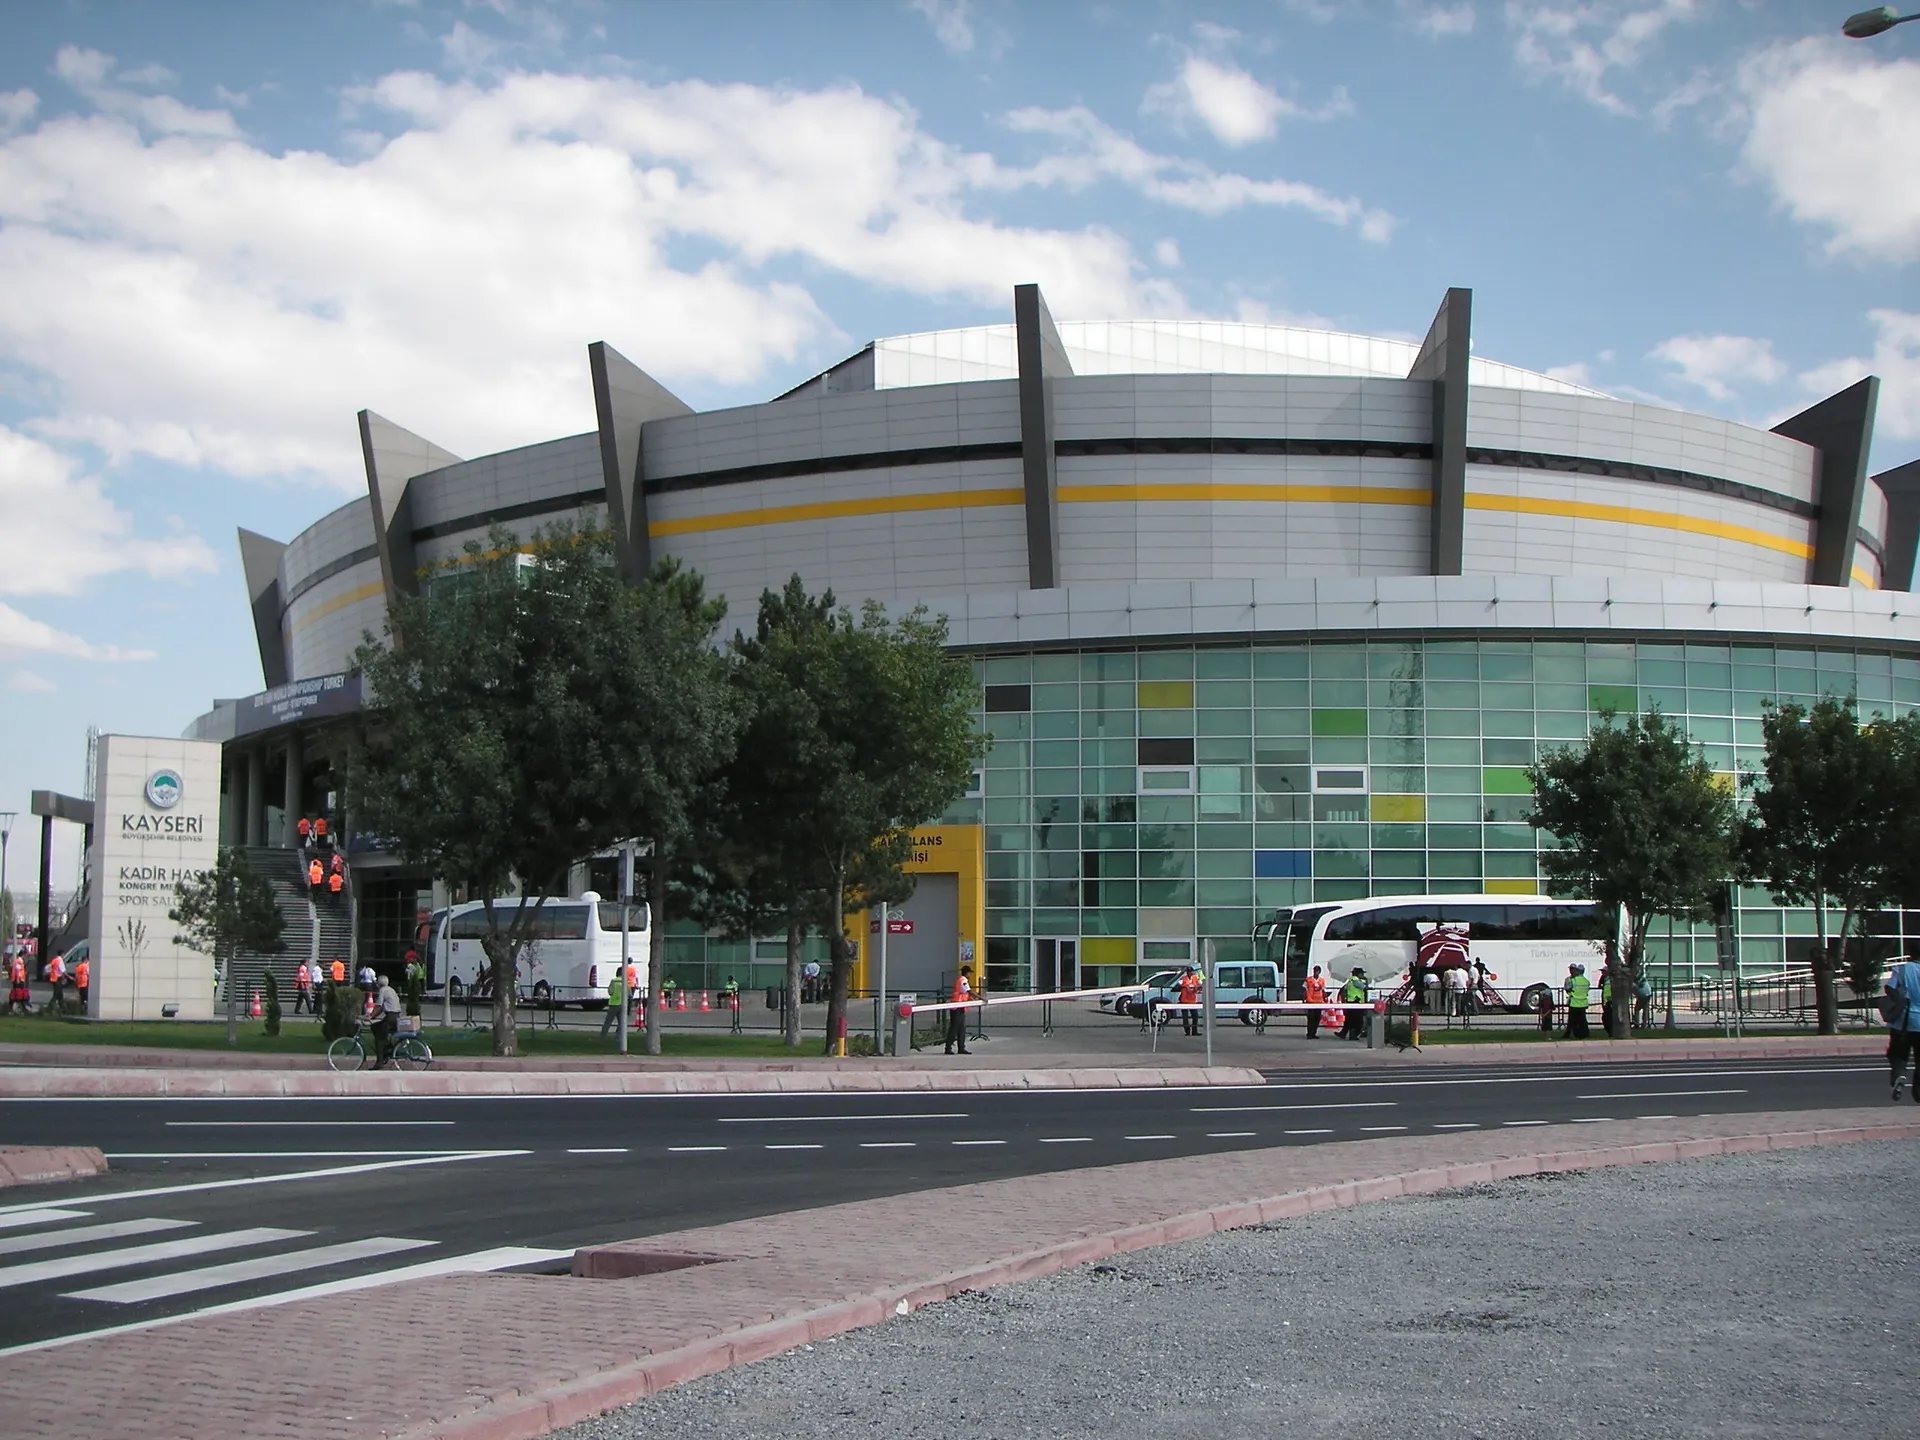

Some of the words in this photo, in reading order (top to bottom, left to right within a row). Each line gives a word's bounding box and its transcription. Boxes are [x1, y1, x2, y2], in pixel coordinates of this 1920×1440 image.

[122, 814, 203, 833] KAYSERİ
[120, 865, 166, 881] KADİR
[119, 882, 157, 891] KONGRE
[119, 895, 149, 905] SPOR
